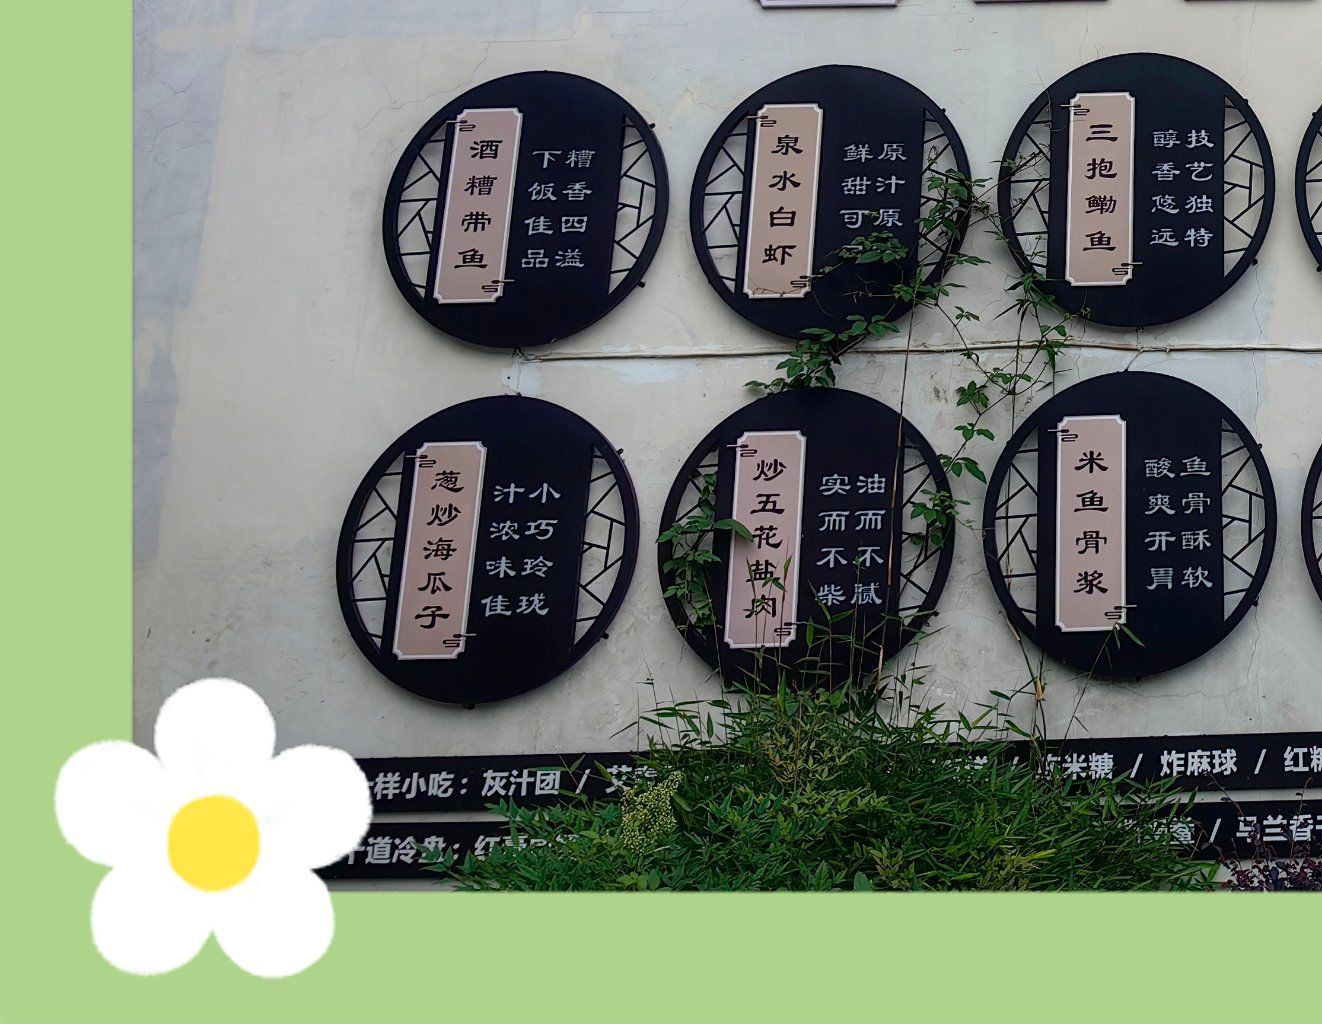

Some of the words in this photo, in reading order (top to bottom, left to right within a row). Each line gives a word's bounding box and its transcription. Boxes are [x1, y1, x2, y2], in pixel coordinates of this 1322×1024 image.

[454, 140, 503, 269] 酒糟带鱼
[521, 149, 562, 268] 下饭佳品
[554, 149, 596, 268] 糟香四溢
[761, 134, 804, 266] 泉水白虾
[840, 143, 873, 252] 鲜甜可
[874, 143, 907, 227] 原汁原
[1082, 123, 1119, 252] 三抱鳓鱼
[1149, 129, 1181, 247] 醇香悠远
[1183, 129, 1215, 248] 技艺独特
[414, 469, 465, 630] 葱炒海瓜子
[480, 483, 524, 617] 汁浓味佳
[516, 482, 561, 616] 小巧玲珑
[742, 458, 787, 619] 炒五花盐肉
[815, 473, 852, 607] 实而不柴
[851, 473, 887, 606] 油而不腻
[1073, 450, 1109, 595] 米鱼骨浆
[1144, 457, 1177, 590] 酸爽开胃
[1179, 455, 1213, 589] 鱼骨酥软
[481, 769, 561, 797] 灰汁团
[1159, 748, 1238, 776] 炸麻球
